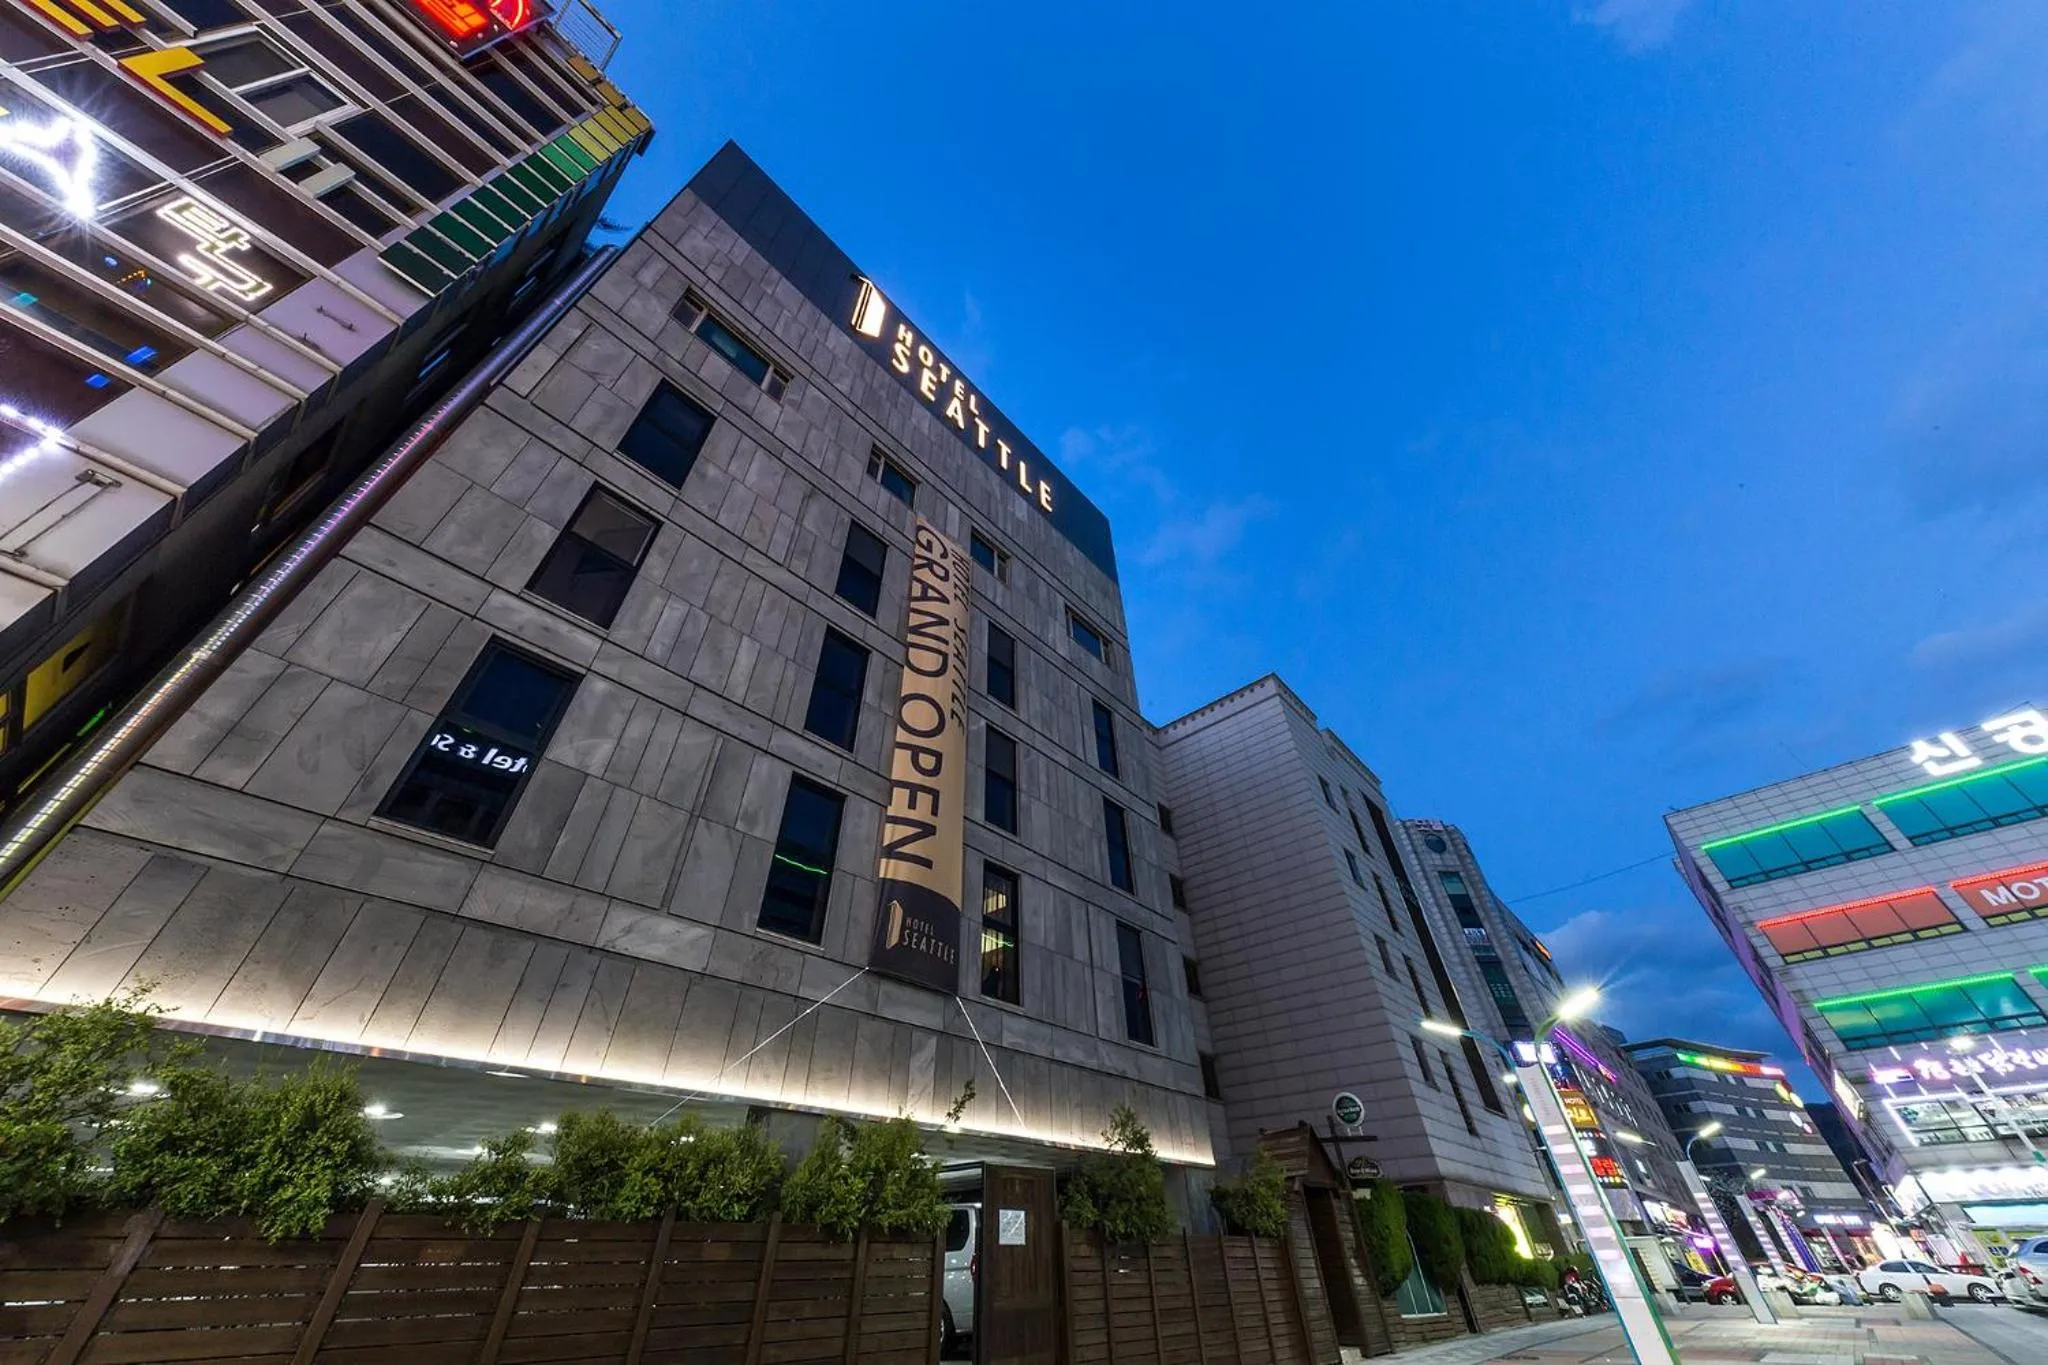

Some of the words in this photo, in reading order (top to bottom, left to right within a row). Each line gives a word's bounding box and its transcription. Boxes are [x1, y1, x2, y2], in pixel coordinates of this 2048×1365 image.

[897, 324, 981, 414] HOTEL
[892, 343, 1053, 512] SEATTLE
[906, 524, 950, 678] GRAND
[951, 549, 970, 612] HOTEL
[951, 618, 969, 735] SEATTLE
[883, 692, 947, 872] OPEN
[903, 929, 957, 965] SEATTLE
[905, 917, 934, 936] HOTEL
